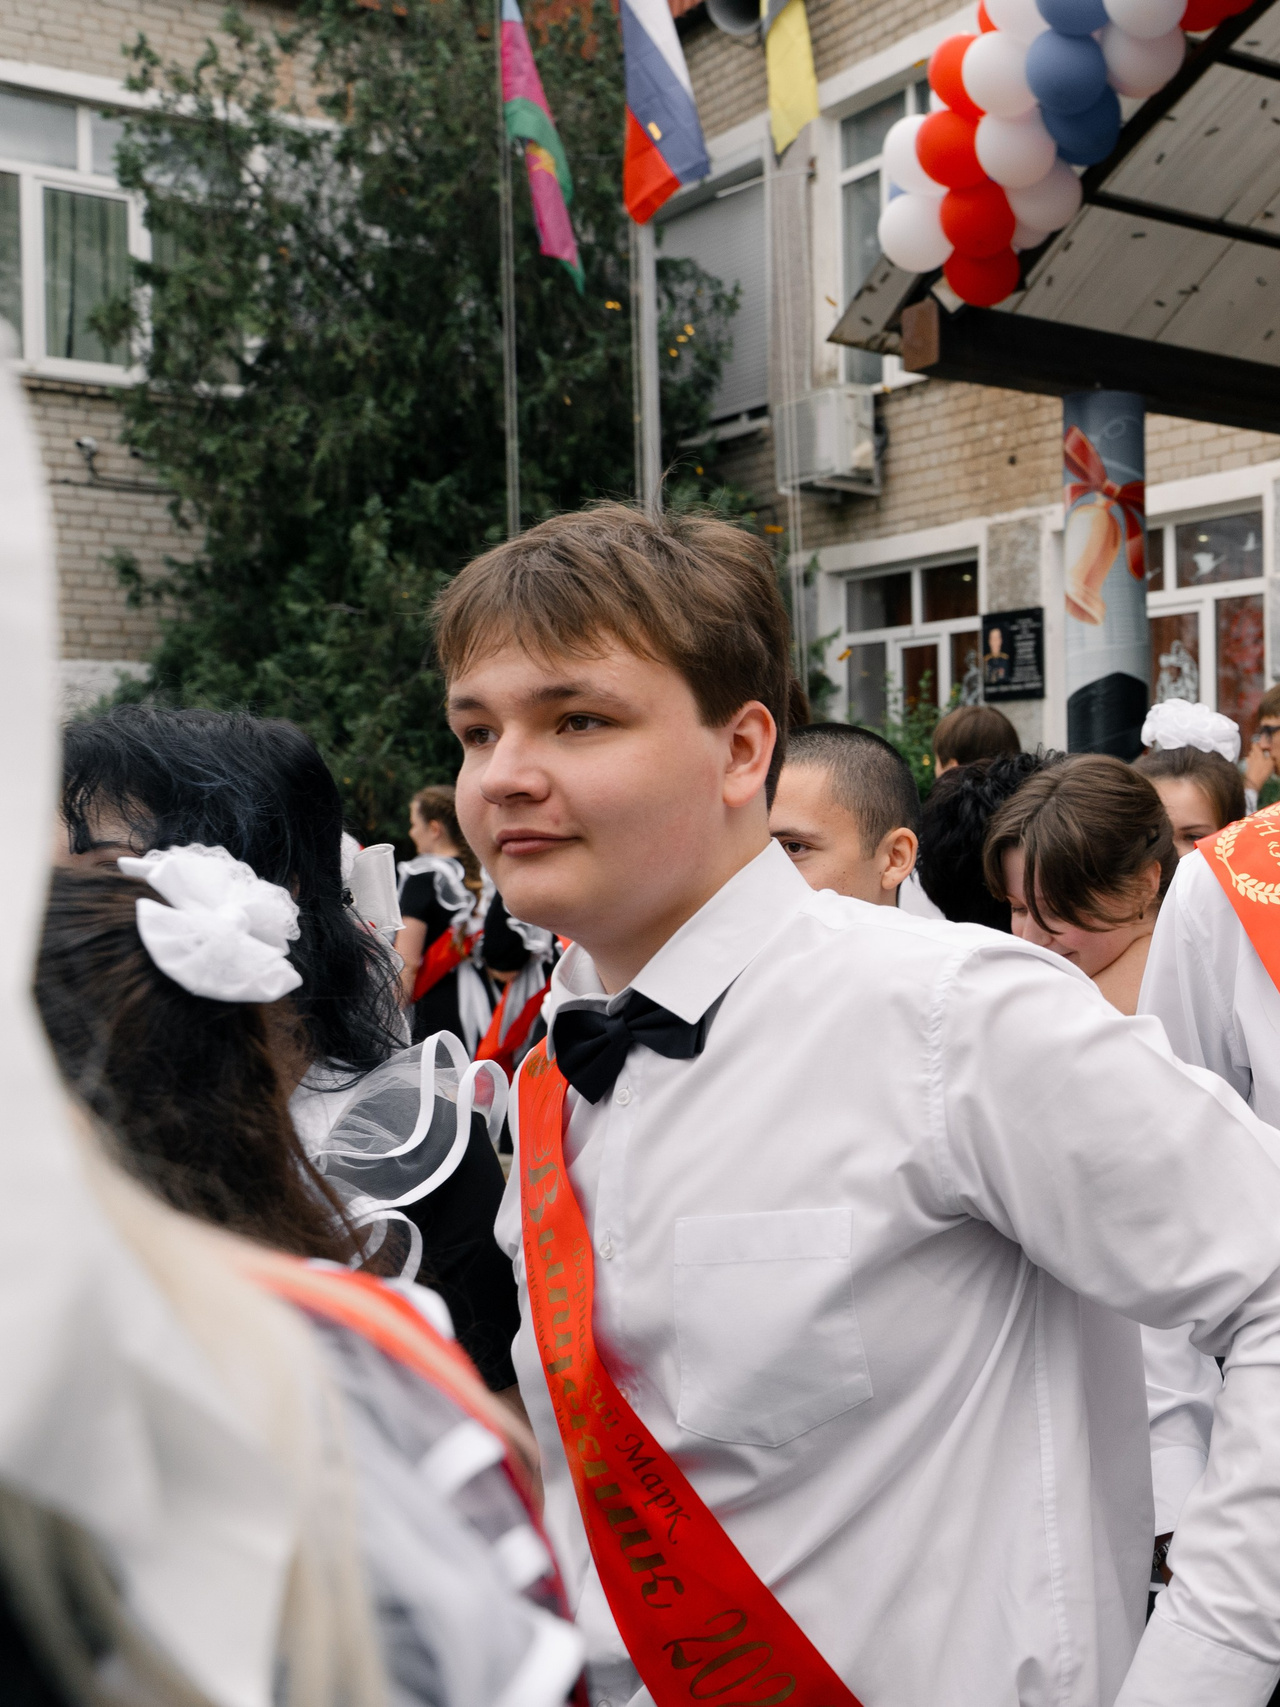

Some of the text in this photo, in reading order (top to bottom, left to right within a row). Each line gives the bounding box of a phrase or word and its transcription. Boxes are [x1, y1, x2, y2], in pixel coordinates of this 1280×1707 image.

[1254, 819, 1280, 837] 11
[614, 1432, 692, 1545] Марк
[661, 1608, 798, 1707] 202
